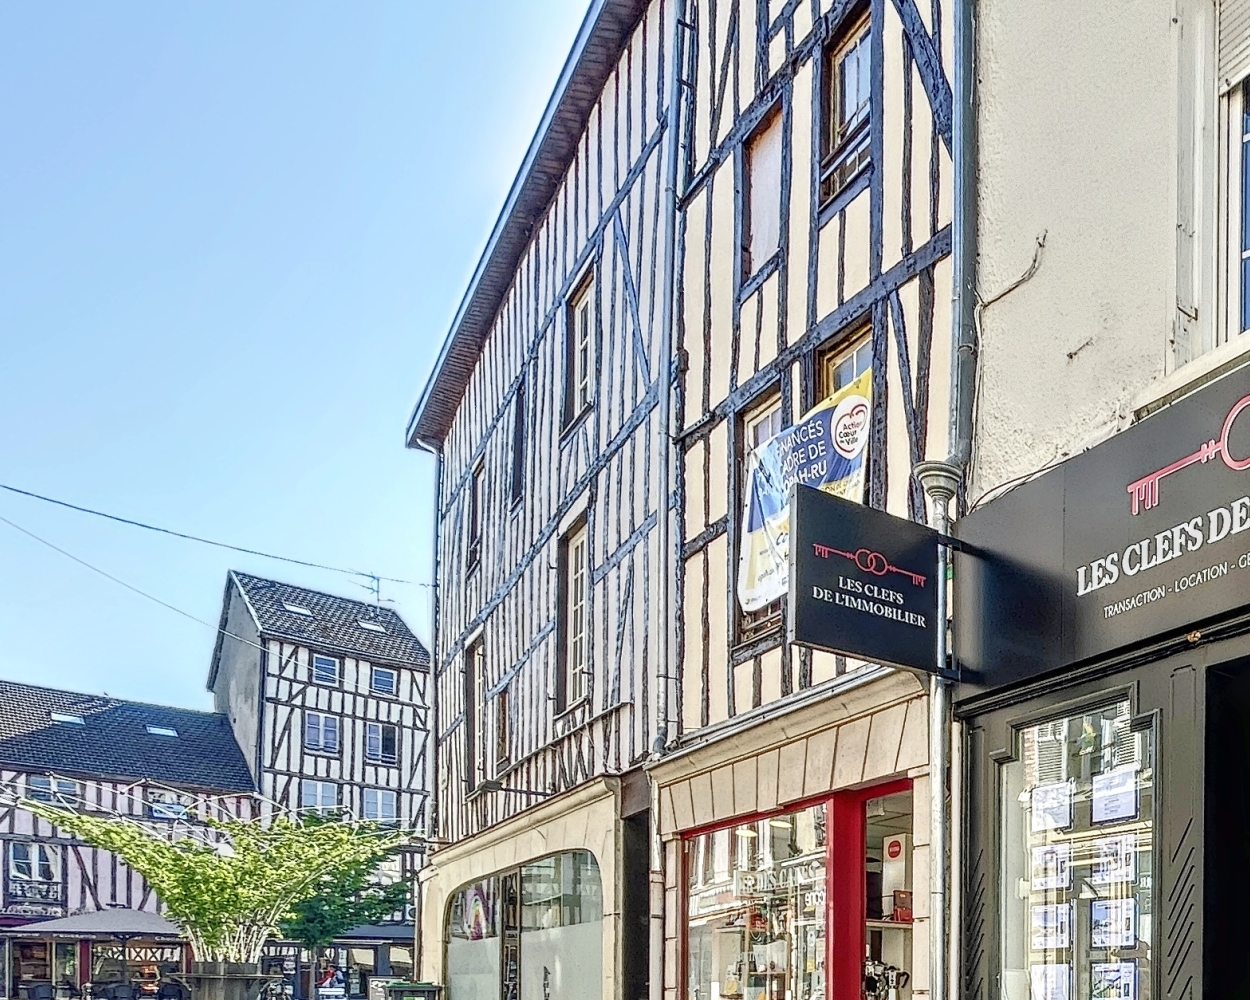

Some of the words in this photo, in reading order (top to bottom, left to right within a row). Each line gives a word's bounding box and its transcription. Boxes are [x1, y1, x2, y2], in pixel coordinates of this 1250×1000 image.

[808, 441, 827, 460] DE
[1076, 552, 1119, 597] LES
[1122, 515, 1203, 576] CLEFS
[812, 586, 833, 603] DE
[835, 592, 927, 628] L'IMMOBILIER
[838, 575, 863, 594] LES
[864, 584, 904, 605] CLEFS
[1103, 585, 1166, 619] TRANSACTION
[1174, 561, 1228, 593] LOCATION
